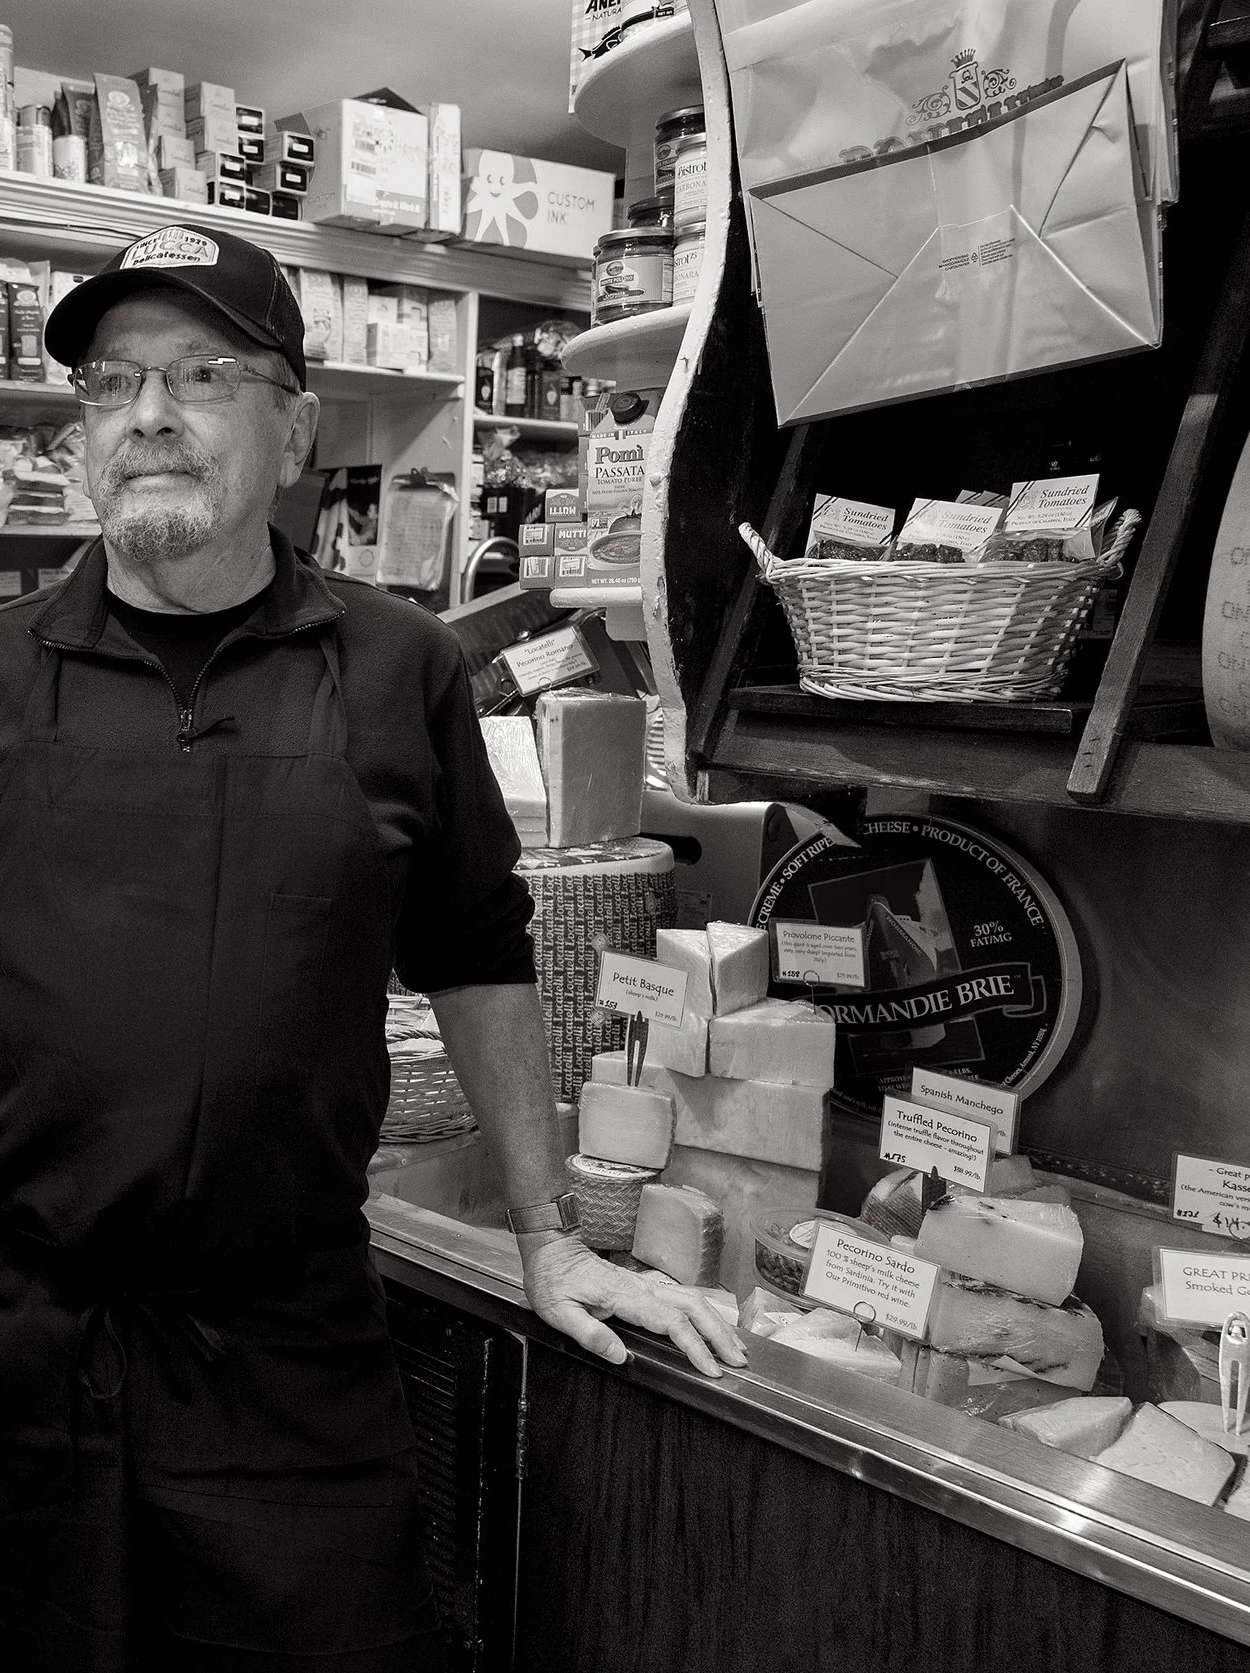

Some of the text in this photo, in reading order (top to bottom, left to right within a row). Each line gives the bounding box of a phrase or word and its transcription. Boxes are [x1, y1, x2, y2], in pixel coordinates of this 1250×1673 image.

[592, 8, 622, 20] NATURA
[678, 161, 707, 179] Bistrot
[677, 180, 706, 193] CARBONA
[548, 191, 595, 213] CUSTOM
[547, 210, 567, 225] INK
[131, 240, 208, 261] LUCCA
[133, 251, 201, 265] Delicatessen
[595, 445, 645, 465] Pomì
[595, 466, 645, 479] PASSATA
[1041, 485, 1089, 498] Sundried
[550, 506, 576, 515] MUTTI
[1038, 497, 1088, 508] Tomatoes
[843, 515, 888, 530] Tomatoes
[844, 507, 889, 521] Sundried
[942, 512, 992, 524] Sundried
[558, 529, 586, 539] MUTTI
[939, 520, 988, 533] Tomatoes
[516, 654, 545, 668] Pecorino
[758, 822, 1044, 926] CREME SOFT RIPE CHEESE PRODUCT OF FRANCE
[544, 899, 554, 947] Locatelli
[564, 900, 575, 947] Locatelli
[973, 920, 1004, 937] 30%
[783, 930, 855, 943] Provolone Piccante
[970, 932, 1013, 949] FAT/MG
[533, 923, 543, 971] Locatelli
[554, 924, 564, 971] Locatelli
[575, 924, 585, 971] Locatelli
[613, 972, 675, 997] Petit Basque
[817, 975, 1015, 1024] ORMANDIE BRIE
[920, 1084, 1004, 1116] Spanish Manchego
[897, 1110, 933, 1129] Truffled
[936, 1122, 978, 1142] Pecorino
[887, 1120, 984, 1156] (intense truffle flavor throughout
[894, 1130, 903, 1138] the
[905, 1134, 922, 1143] entire
[924, 1140, 942, 1150] cheese
[1217, 1168, 1242, 1178] Great
[1181, 1184, 1233, 1199] (the American
[1223, 1180, 1250, 1193] Kass
[1219, 1201, 1239, 1209] cow's
[836, 1238, 915, 1274] Pecorino Sardo
[827, 1249, 842, 1259] 100
[850, 1258, 876, 1273] sheep's
[877, 1268, 894, 1279] milk
[895, 1275, 920, 1289] cheese
[1182, 1266, 1228, 1280] GREAT
[826, 1260, 844, 1272] from
[845, 1268, 875, 1284] Sardinia.
[878, 1278, 890, 1290] Try
[899, 1286, 916, 1298] with
[1185, 1280, 1233, 1295] Smoked
[825, 1271, 910, 1308] Our Primitivo red wine.
[885, 1313, 918, 1330] $29.99/lb
